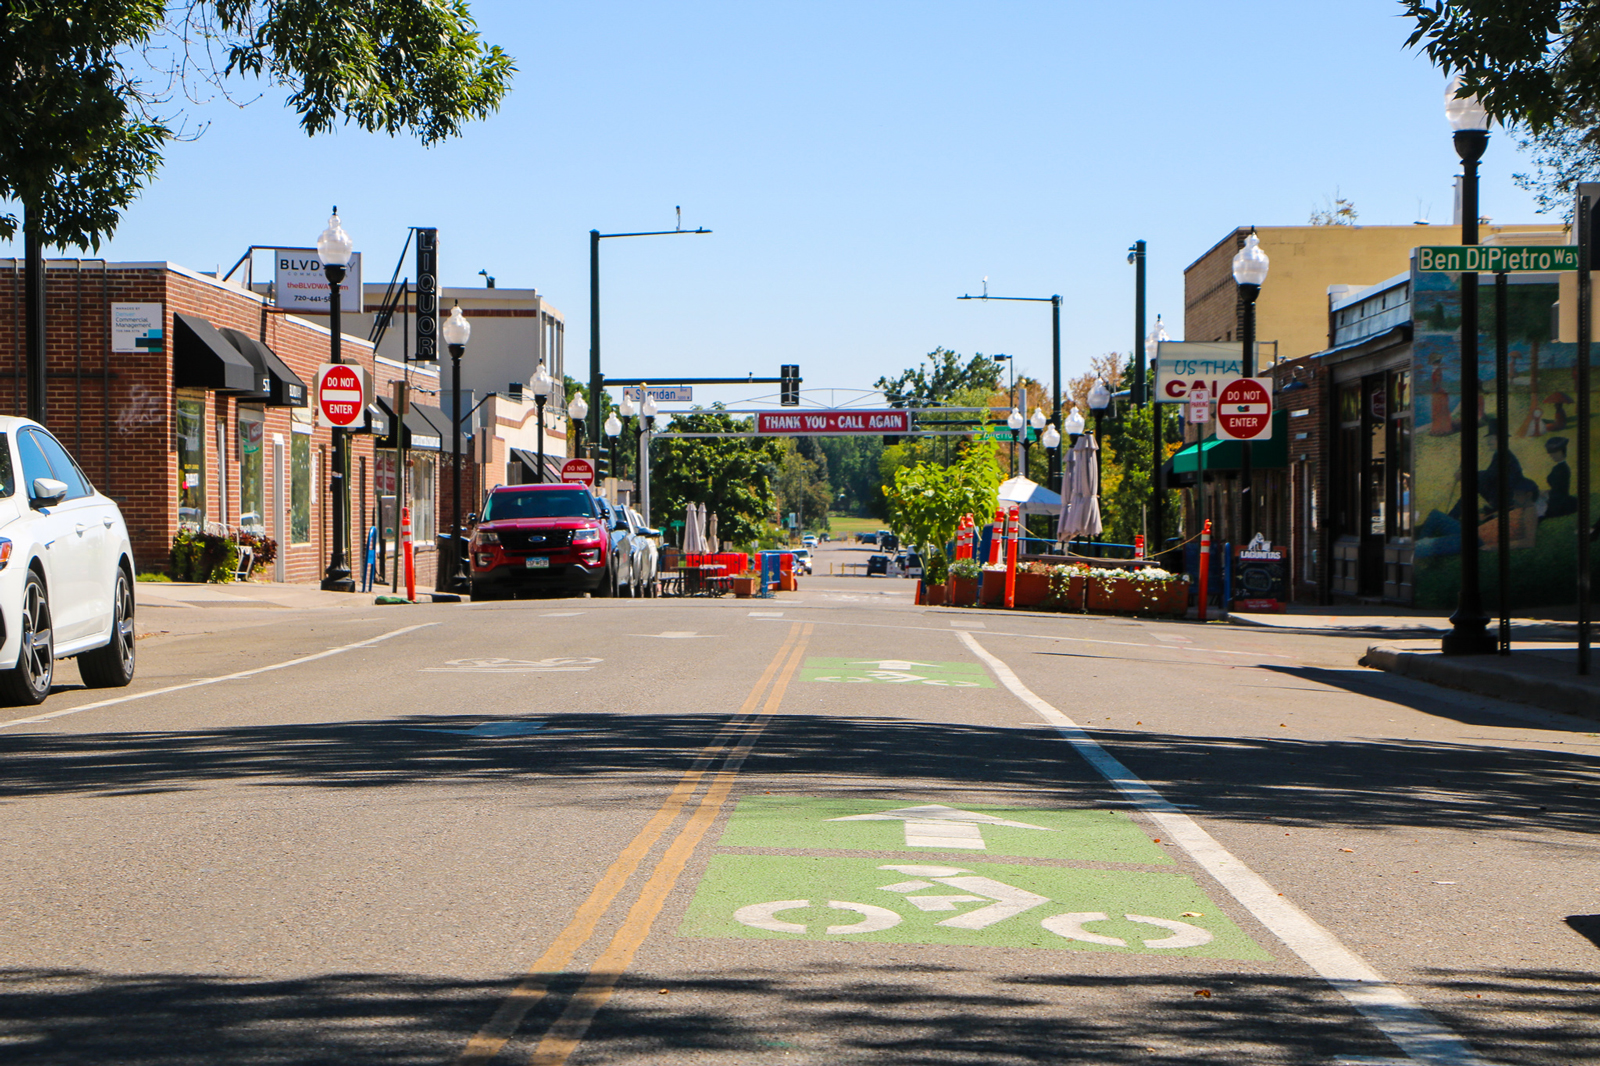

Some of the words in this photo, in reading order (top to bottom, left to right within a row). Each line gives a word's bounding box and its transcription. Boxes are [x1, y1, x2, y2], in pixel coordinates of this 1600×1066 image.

[1420, 248, 1460, 270] Ben
[1466, 248, 1550, 270] DiPietro
[1554, 249, 1579, 268] Way
[418, 231, 435, 355] LIQUOR
[1174, 360, 1197, 376] US
[1200, 360, 1244, 375] THA
[327, 377, 338, 387] DO
[340, 378, 354, 388] NOT
[1227, 391, 1240, 401] DO
[1243, 391, 1261, 401] NOT
[329, 404, 353, 414] ENTER
[764, 415, 801, 429] THANK
[805, 415, 827, 429] YOU
[837, 415, 865, 429] CALL
[868, 415, 902, 429] AGAIN
[1229, 417, 1258, 428] ENTER
[1240, 550, 1281, 560] LAGUNITAS
